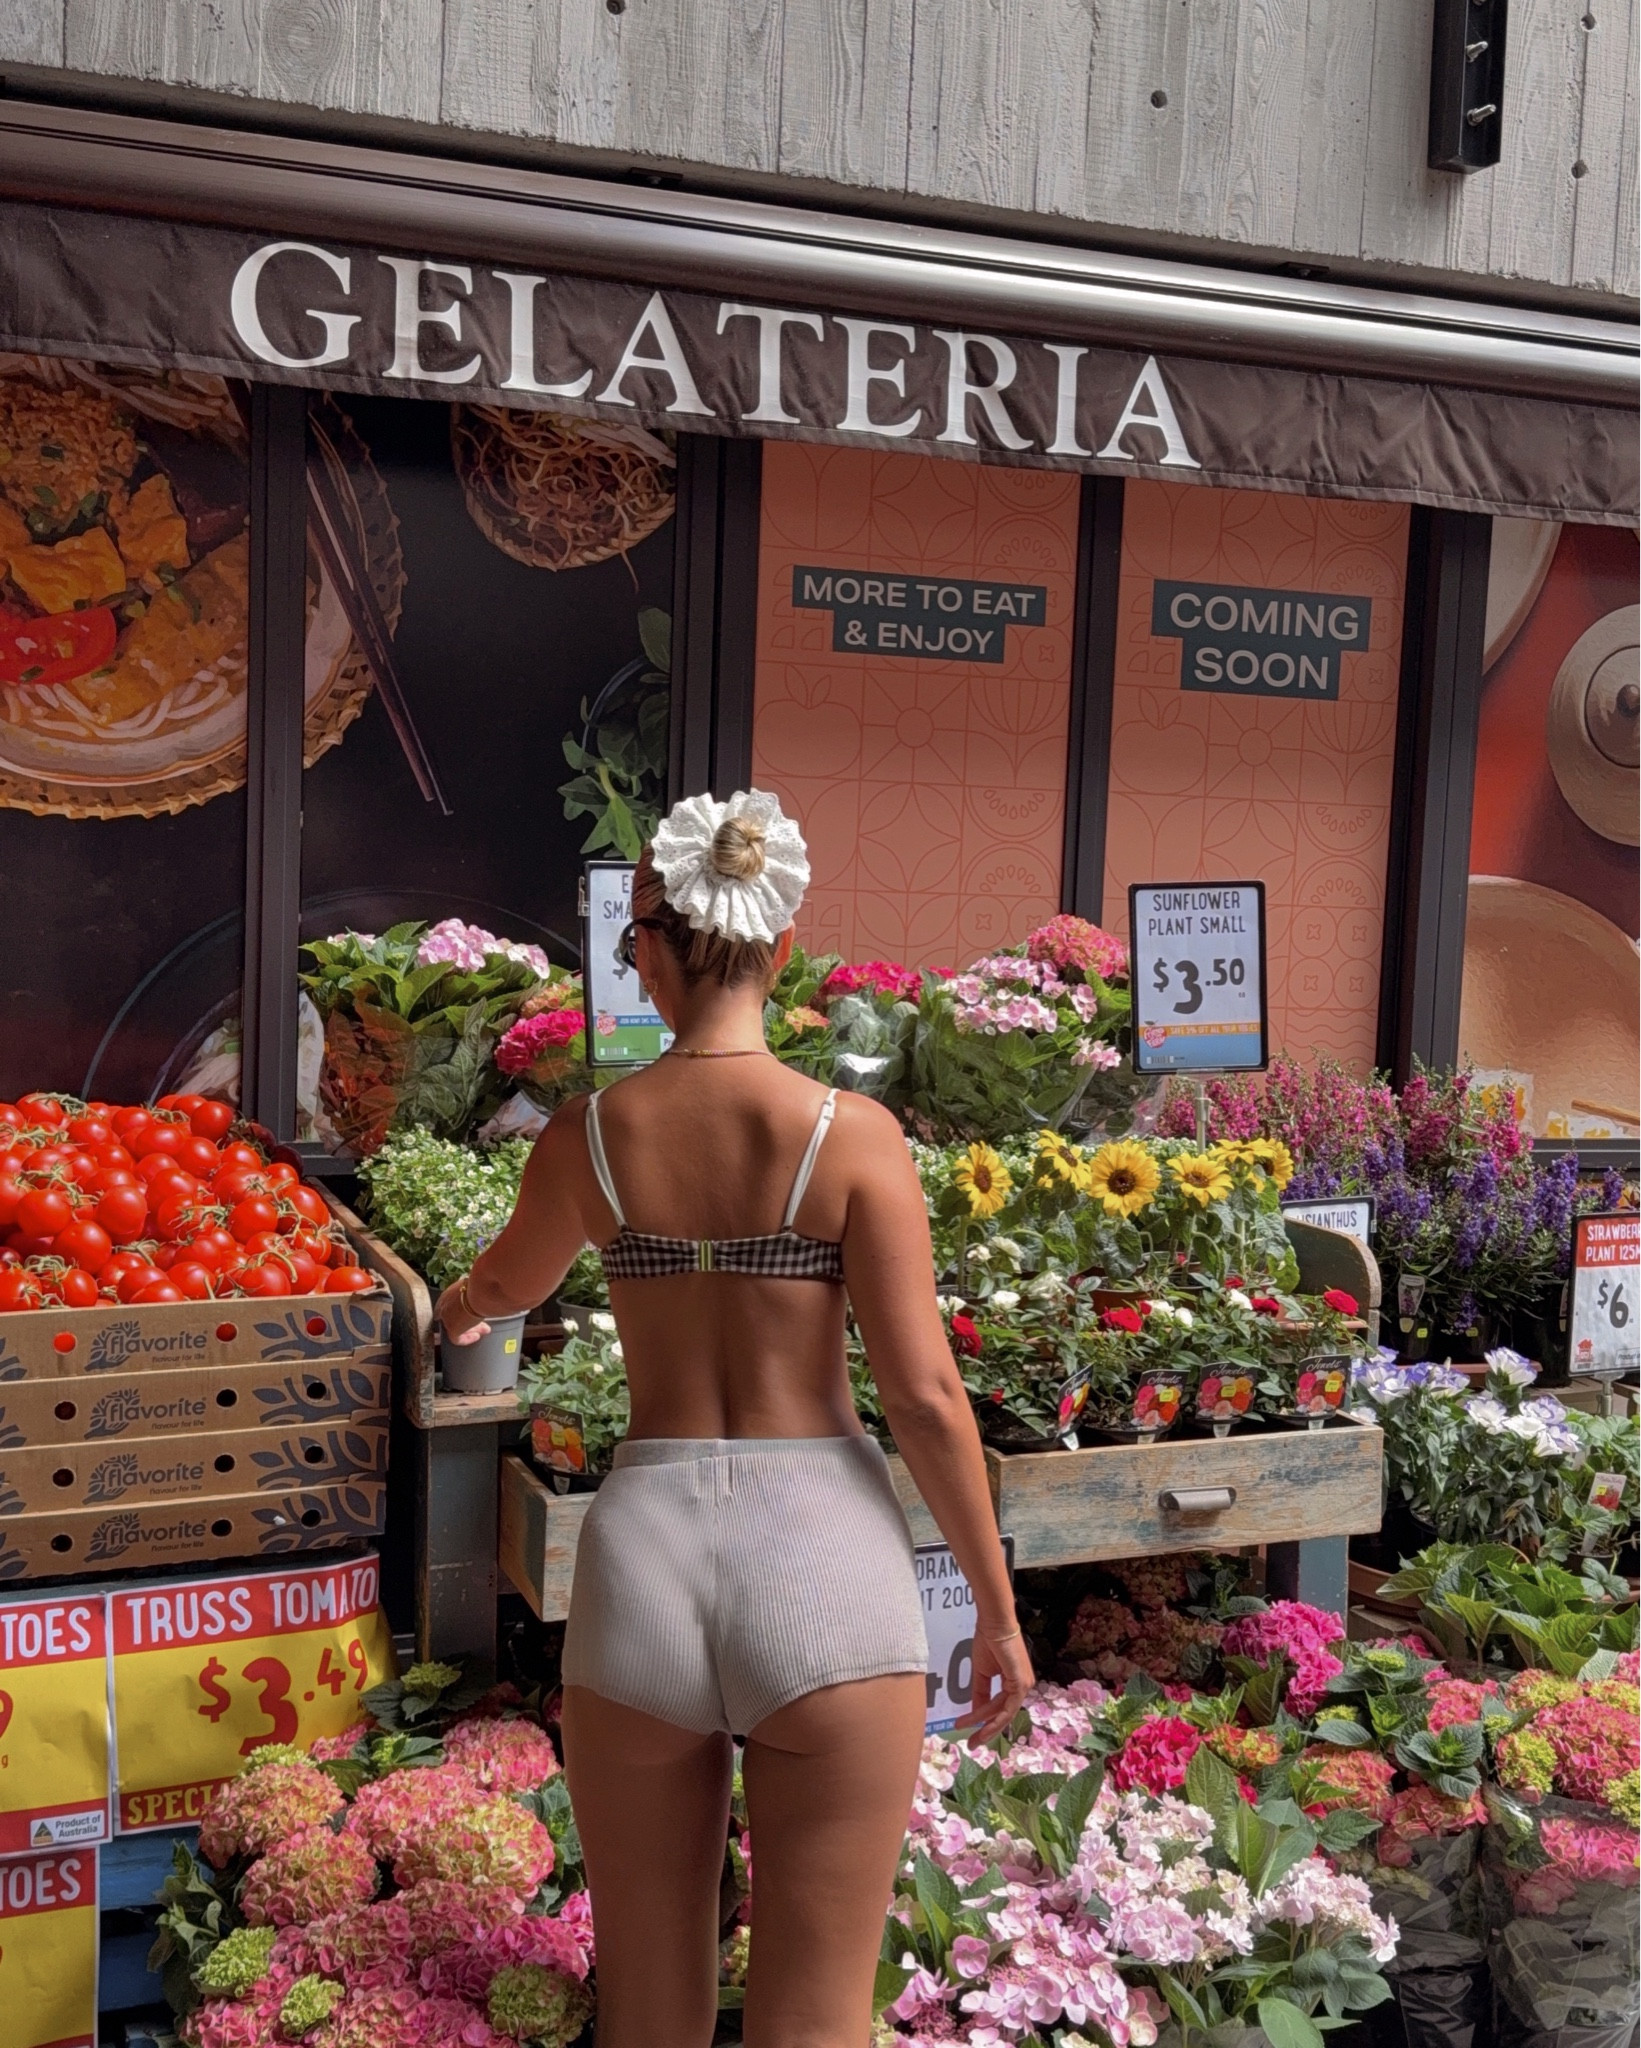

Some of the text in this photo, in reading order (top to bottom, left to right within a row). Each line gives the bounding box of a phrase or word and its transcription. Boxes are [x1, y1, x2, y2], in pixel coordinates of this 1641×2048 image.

[231, 241, 1201, 469] GELATERIA
[803, 574, 1036, 618] MORE TO EAT
[1170, 592, 1359, 641] COMING
[844, 620, 994, 655] & ENJOY
[1194, 647, 1329, 690] SOON
[1153, 890, 1240, 912] SUNFLOWER
[1148, 915, 1246, 936] PLANT SMALL
[1153, 957, 1245, 1015] $3.50
[1586, 1245, 1616, 1262] PLANT
[126, 1566, 379, 1645] TRUSS TOMATO
[1, 1607, 91, 1661] TOES
[198, 1638, 368, 1757] $3.49
[55, 1814, 101, 1829] Product of
[58, 1825, 98, 1838] Australia
